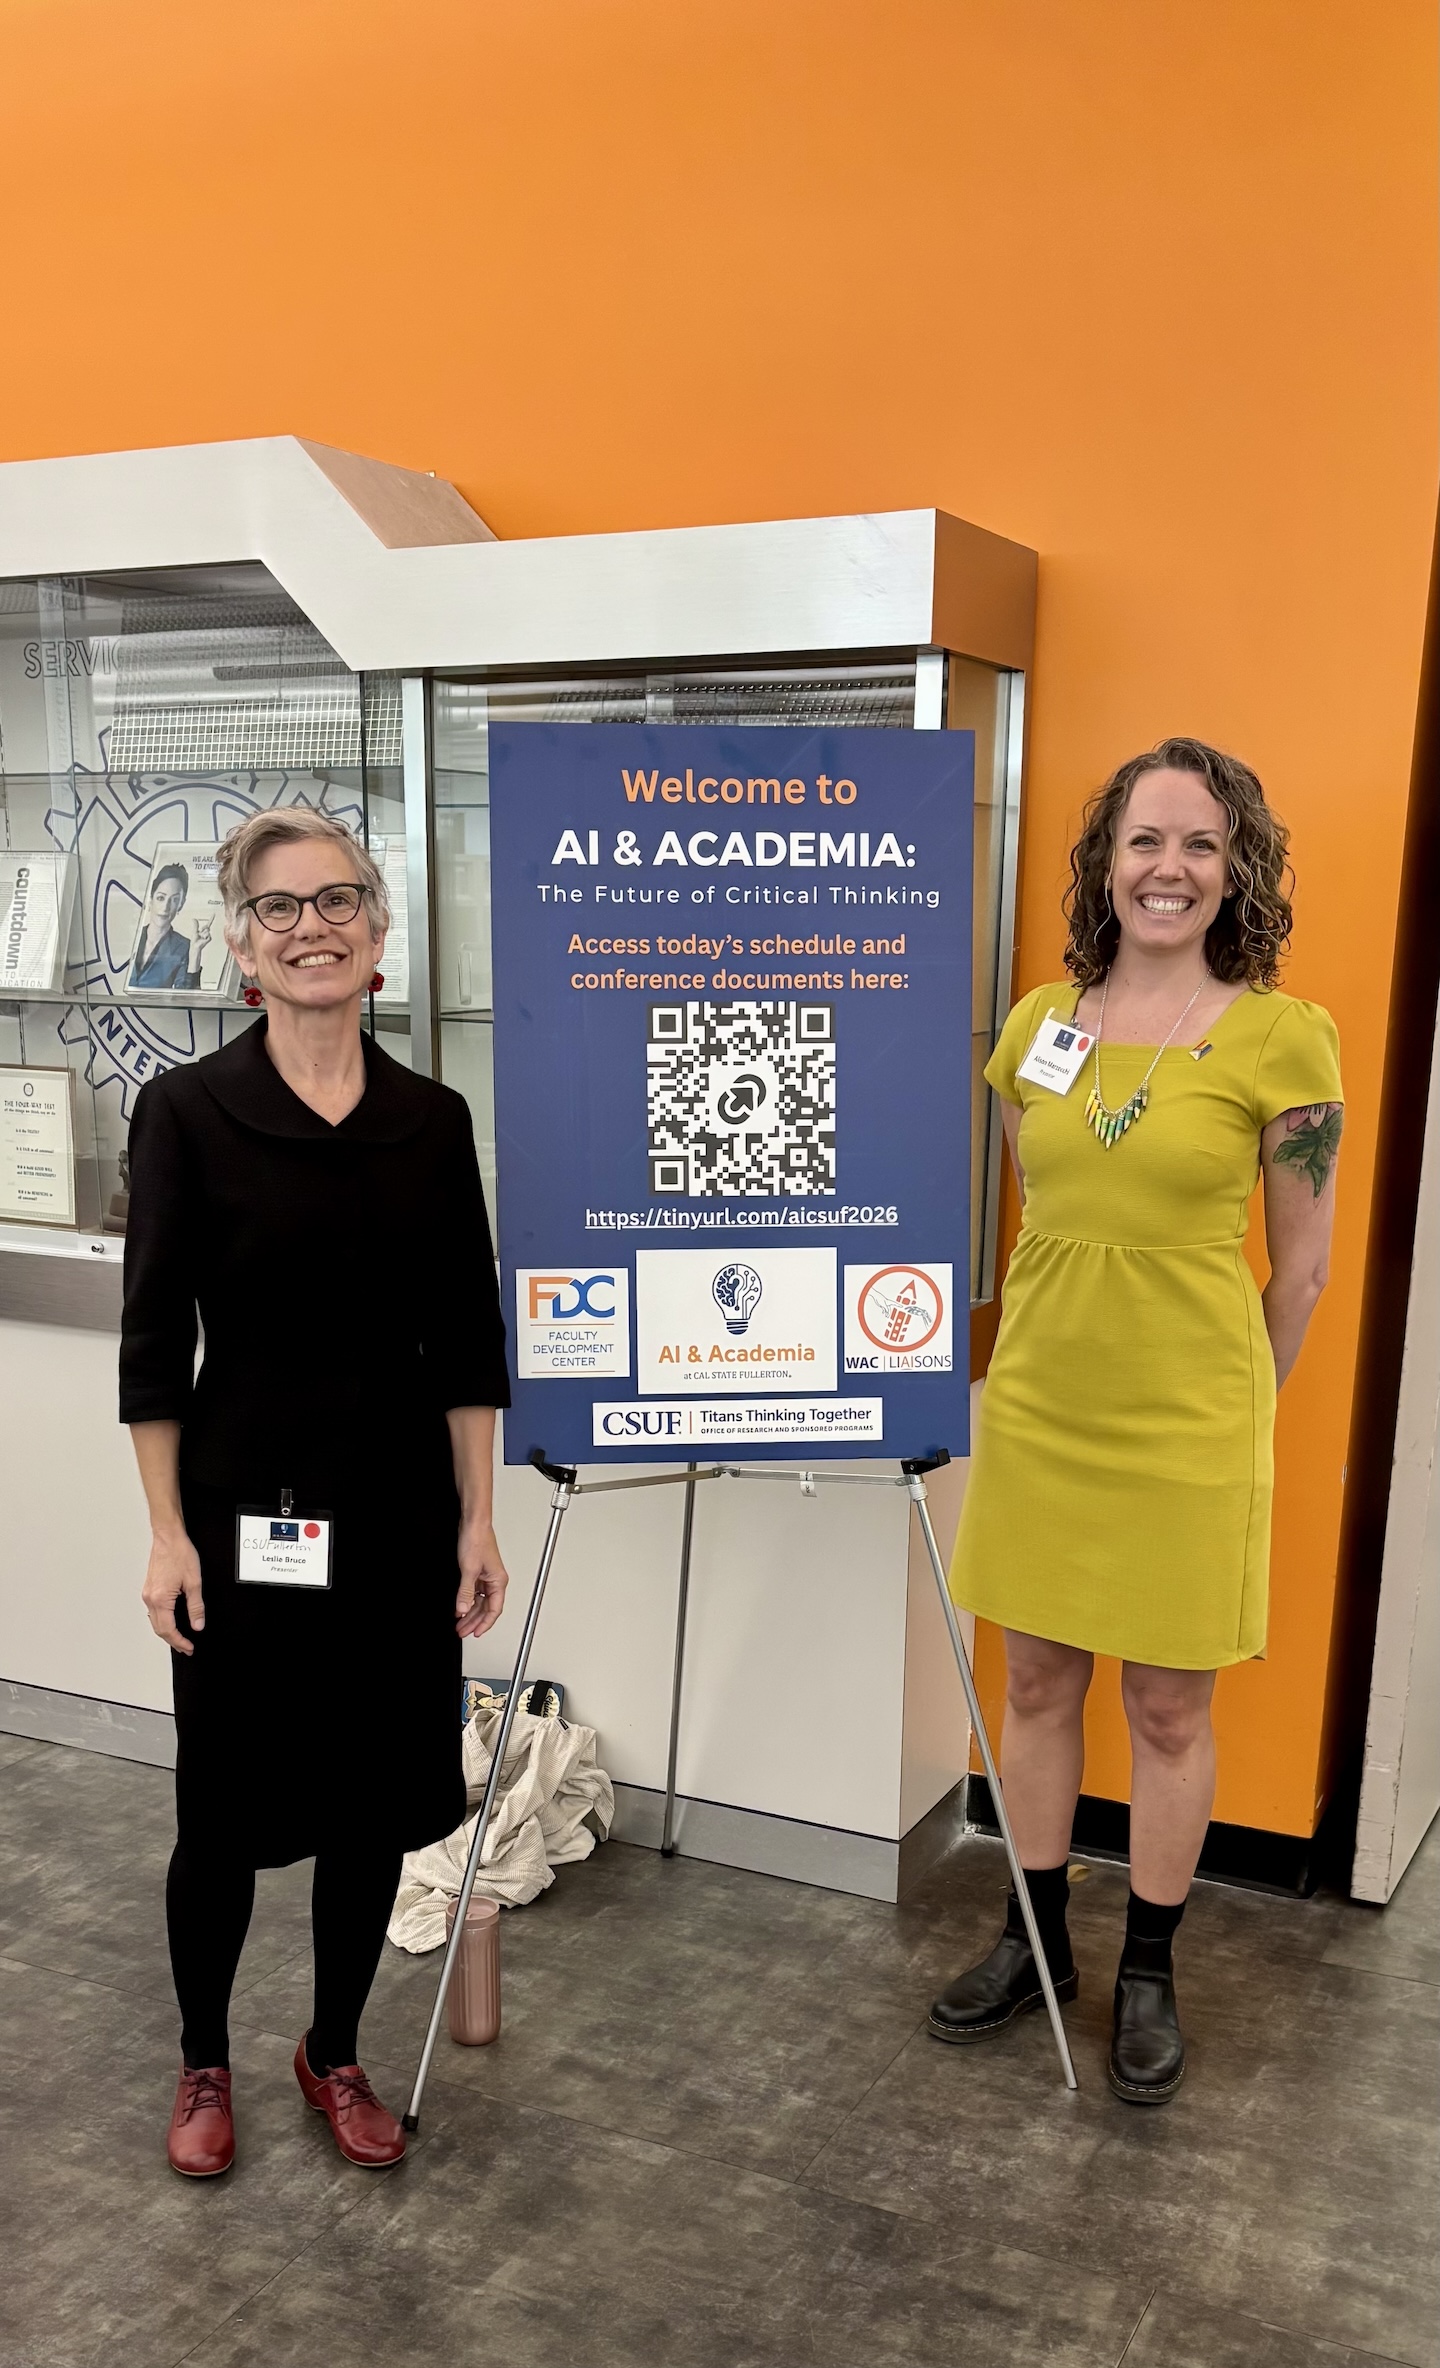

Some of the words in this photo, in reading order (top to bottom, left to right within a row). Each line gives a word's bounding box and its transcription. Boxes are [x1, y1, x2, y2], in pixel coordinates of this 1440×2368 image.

[621, 768, 806, 805] Welcome
[816, 774, 858, 805] to
[551, 829, 599, 865] AI
[613, 830, 643, 867] &
[653, 830, 916, 868] ACADEMIA:
[537, 885, 583, 903] The
[596, 885, 680, 904] Future
[691, 885, 716, 904] of
[725, 885, 818, 904] Critical
[828, 886, 940, 909] Thinking
[5, 867, 30, 970] countdown
[567, 933, 651, 955] Access
[749, 934, 856, 955] schedule
[862, 933, 906, 955] and
[570, 968, 706, 990] conference
[711, 968, 844, 990] documents
[851, 969, 909, 990] here:
[585, 1205, 899, 1230] https://tinyurl.com/aicsuf2026
[528, 1274, 616, 1319] FDC
[548, 1331, 598, 1341] FACULTY
[533, 1344, 615, 1354] DEVELOPMENT
[658, 1345, 680, 1363] AI
[687, 1345, 702, 1363] &
[708, 1343, 815, 1362] Academia
[552, 1357, 596, 1367] CENTER
[846, 1356, 879, 1369] WAC
[889, 1354, 952, 1369] LIAISONS
[693, 1371, 710, 1380] CAL
[711, 1371, 737, 1379] STATE
[700, 1410, 743, 1422] Titans
[745, 1409, 806, 1424] Thinking
[809, 1407, 872, 1423] Together
[262, 1555, 283, 1563] Leslie
[285, 1556, 306, 1564] Bruce
